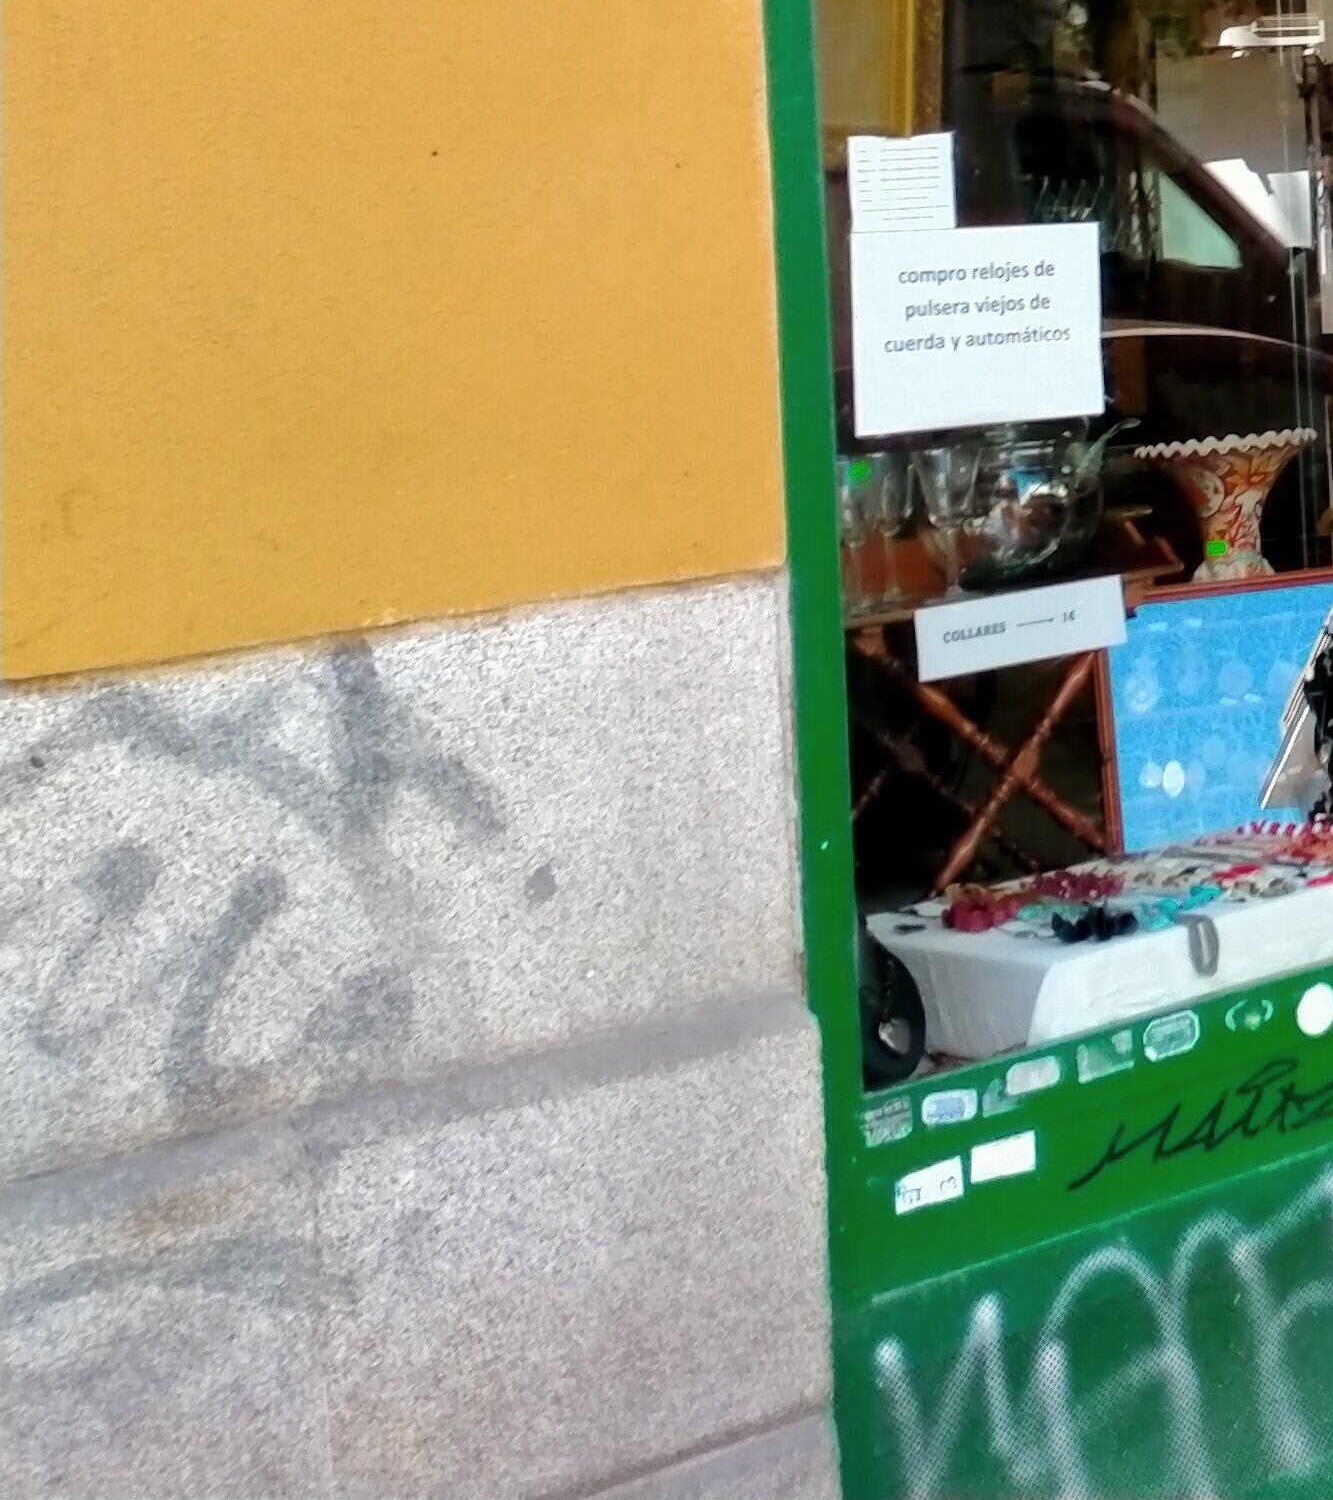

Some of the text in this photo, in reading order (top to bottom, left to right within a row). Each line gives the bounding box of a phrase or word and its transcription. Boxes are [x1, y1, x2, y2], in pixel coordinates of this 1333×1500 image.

[898, 259, 1056, 286] compro relojes de
[905, 292, 1051, 322] pulsera viejos de
[884, 325, 1071, 353] cuerda y automáticos
[942, 621, 1006, 645] COLLARES
